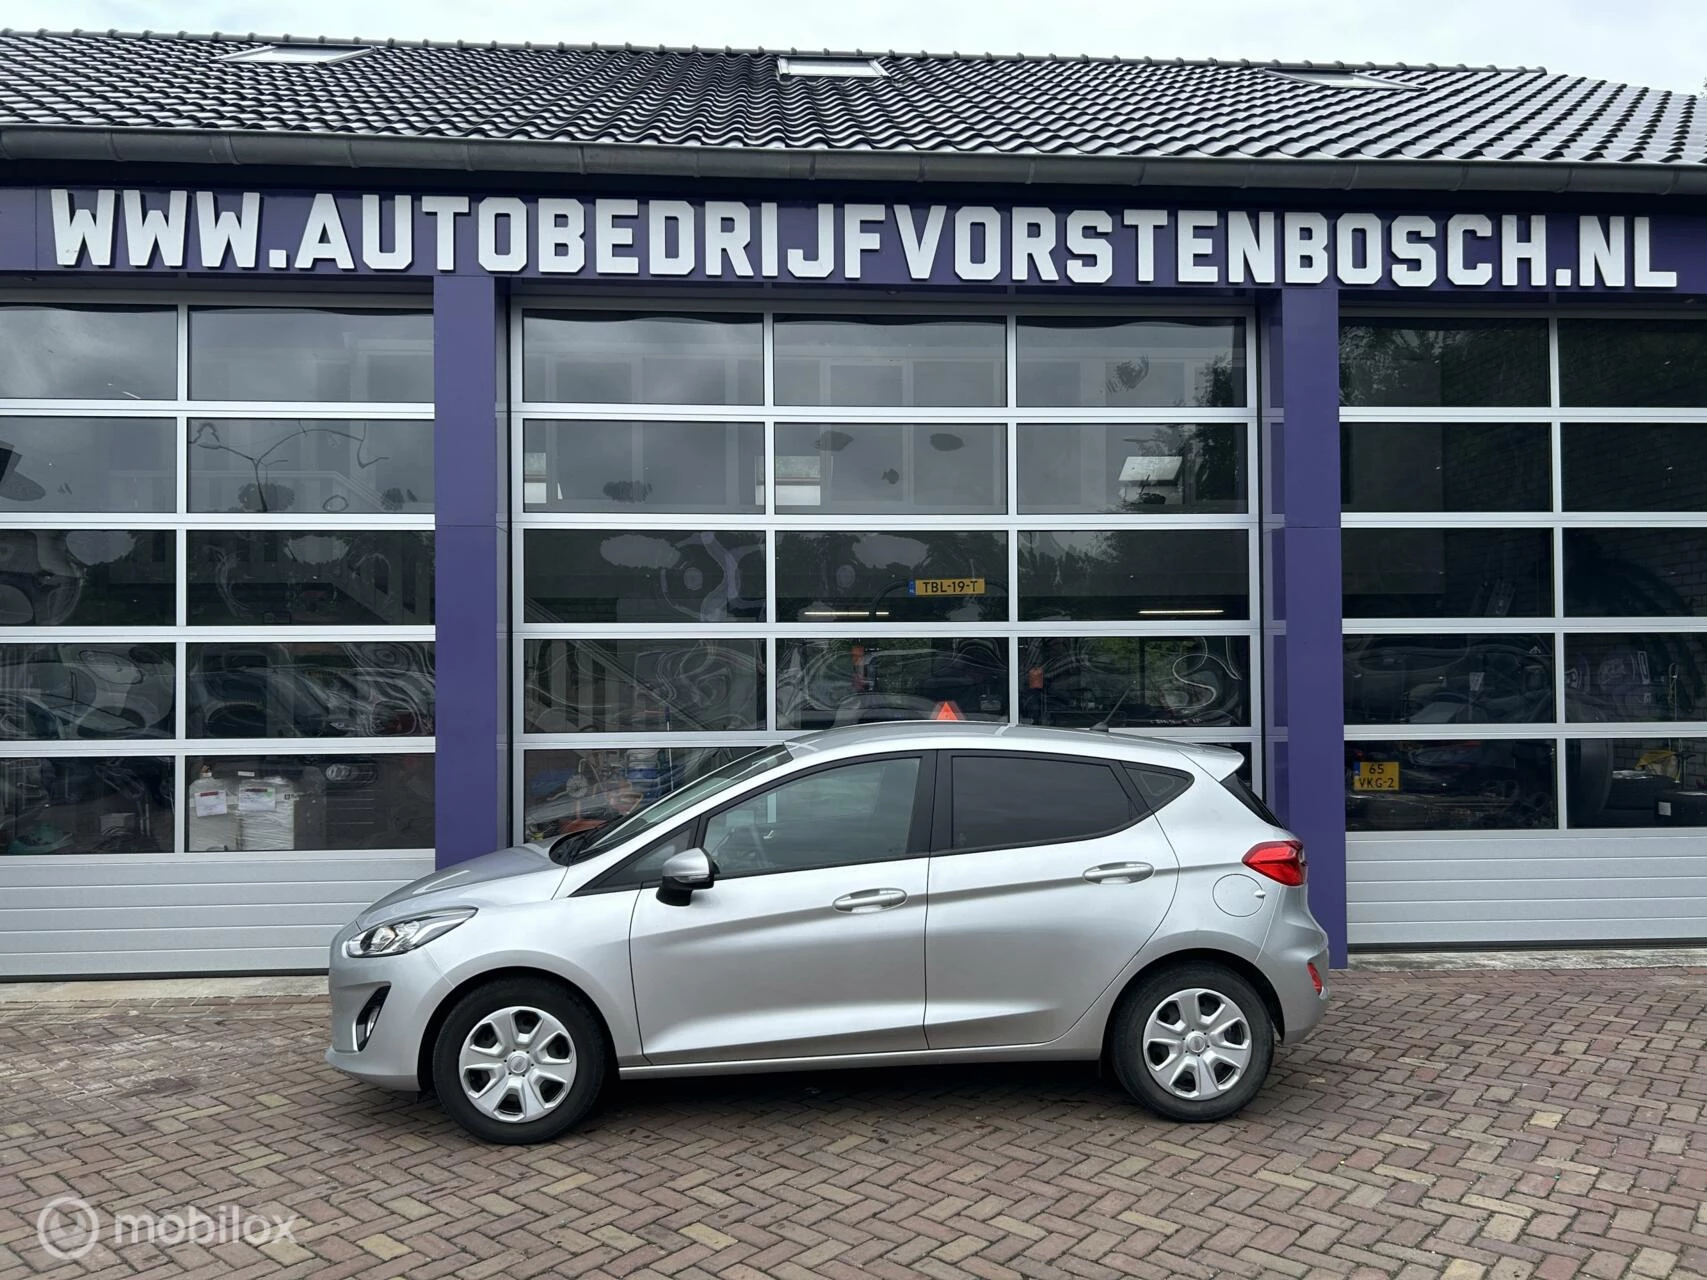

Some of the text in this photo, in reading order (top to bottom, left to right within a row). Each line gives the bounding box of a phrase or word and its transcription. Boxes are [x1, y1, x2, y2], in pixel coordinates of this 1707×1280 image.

[51, 189, 1677, 288] WWW.AUTOBEDRIJFVORSTENBOSCH.NL
[922, 581, 978, 593] TBL-19-T
[1369, 763, 1384, 774] 65
[1359, 777, 1394, 788] VKG-2
